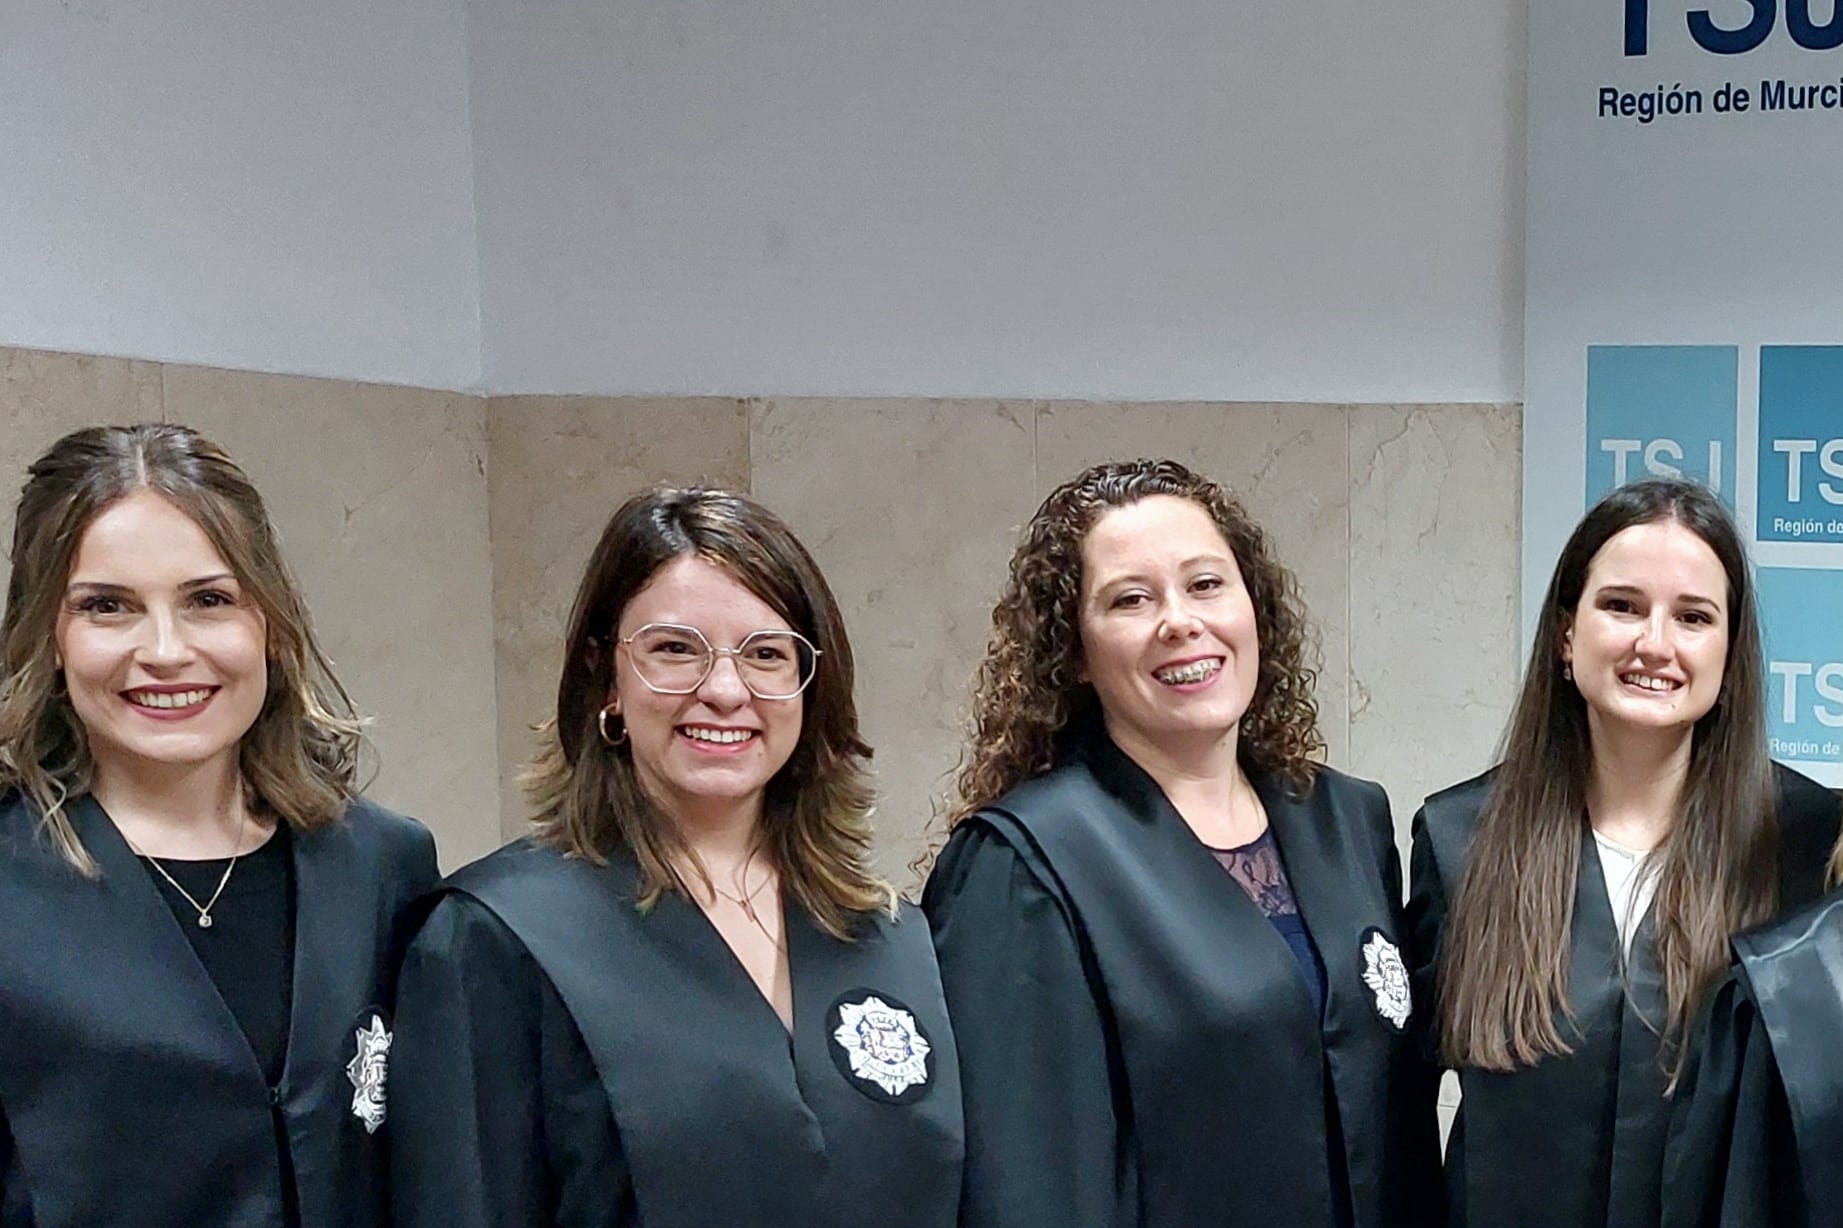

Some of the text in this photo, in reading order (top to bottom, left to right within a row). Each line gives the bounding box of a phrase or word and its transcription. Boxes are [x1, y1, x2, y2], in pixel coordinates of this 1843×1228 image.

[1598, 83, 1702, 123] Región
[1713, 82, 1750, 112] de
[1774, 517, 1823, 537] Región
[1827, 520, 1843, 534] de
[1822, 741, 1841, 756] de
